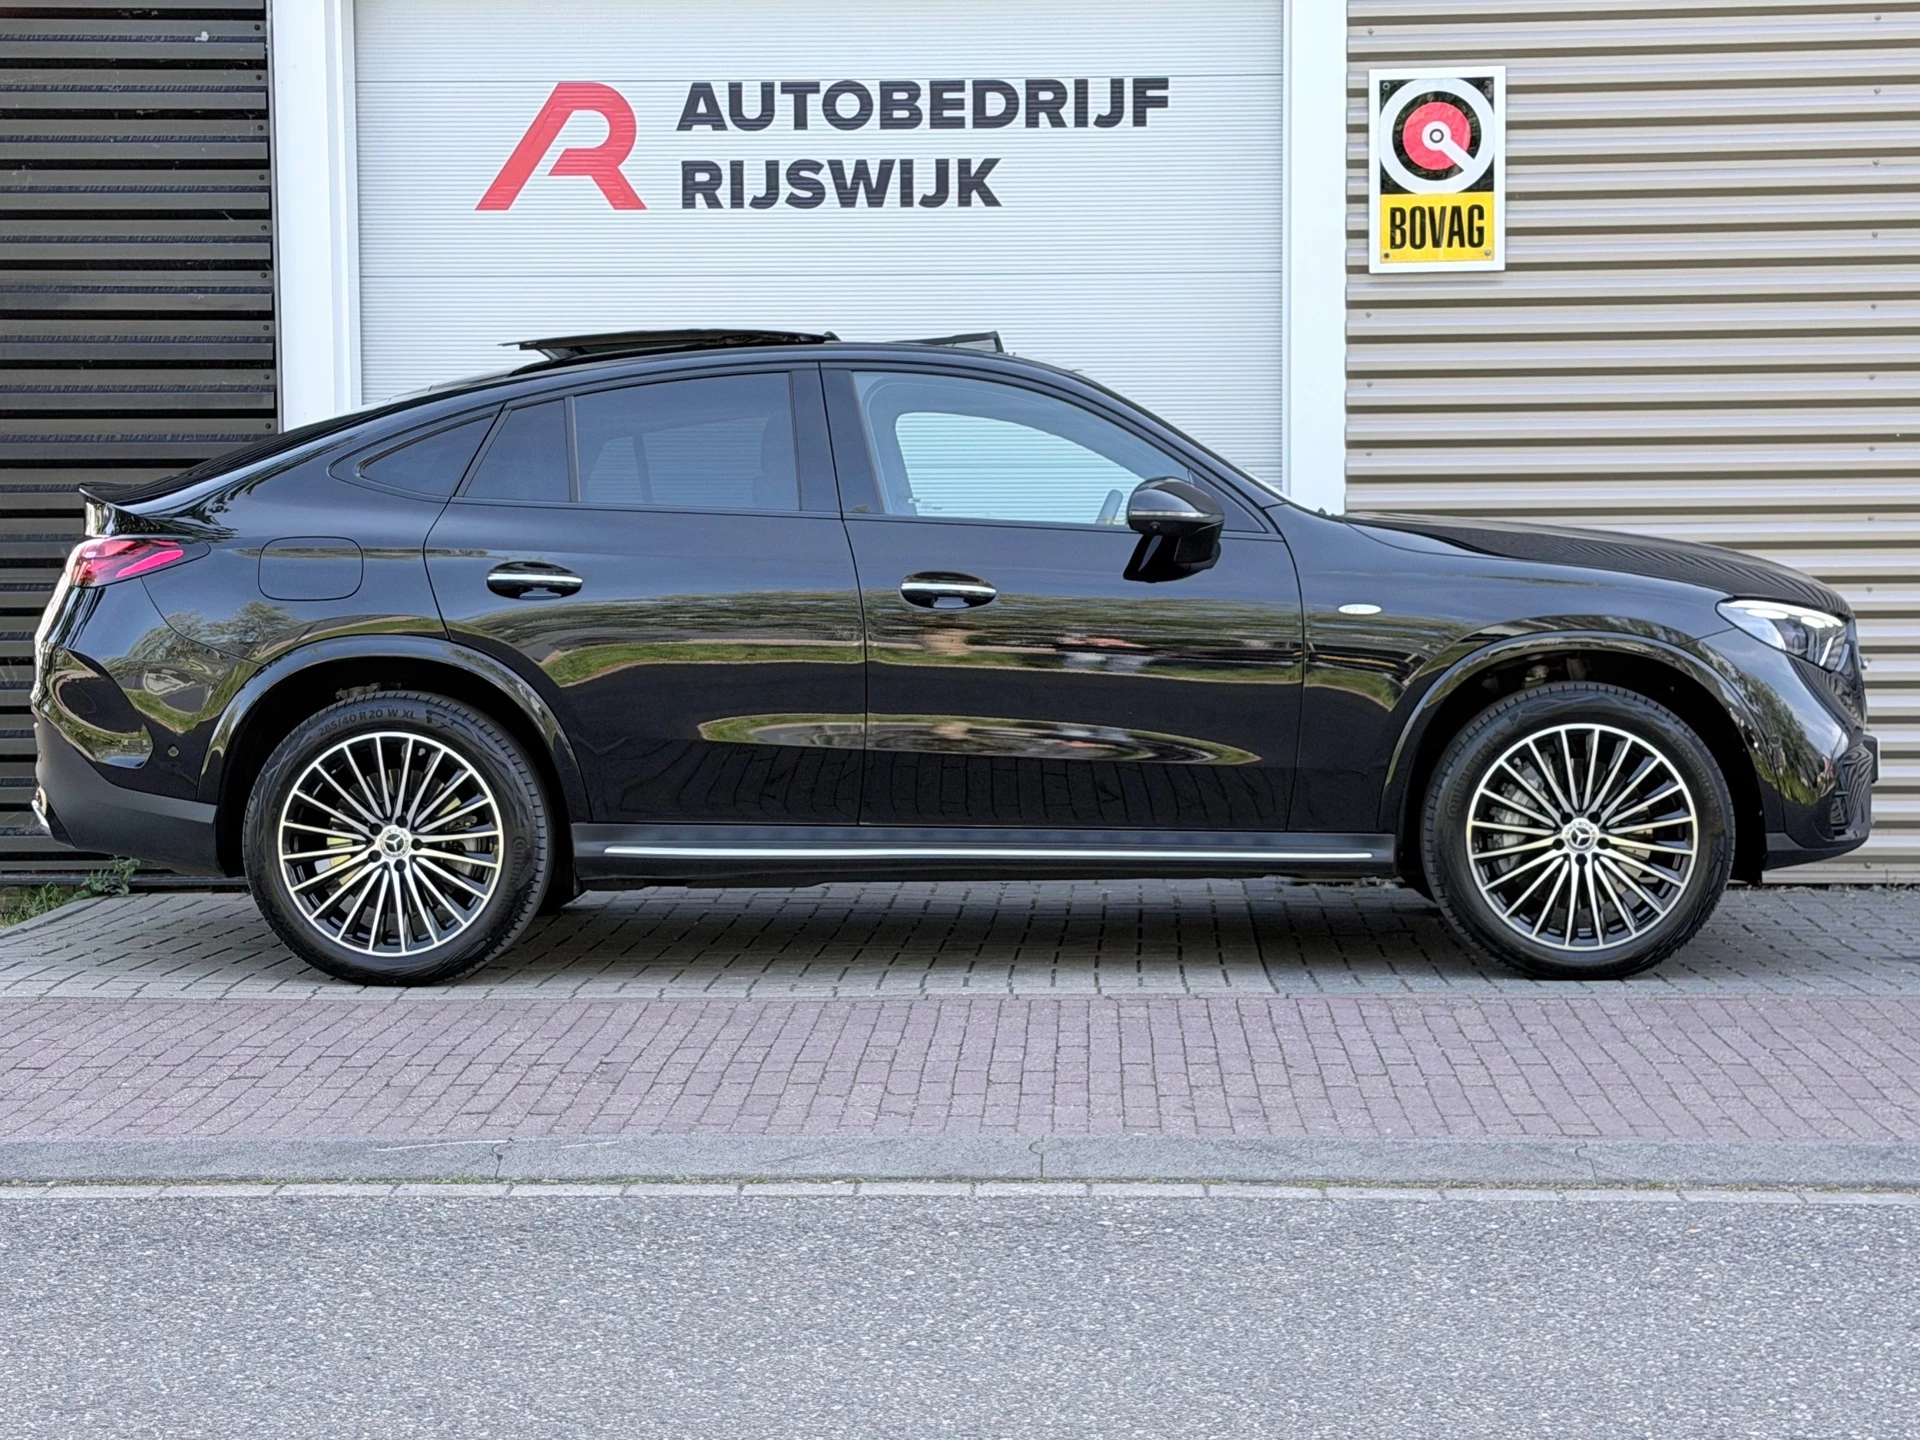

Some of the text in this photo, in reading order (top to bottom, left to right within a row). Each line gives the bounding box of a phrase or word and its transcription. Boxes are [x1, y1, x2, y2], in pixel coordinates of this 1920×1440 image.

[676, 77, 1169, 131] AUTOBEDRIJF
[680, 158, 1002, 210] RIJSWIJK
[1389, 204, 1485, 249] BOVAG
